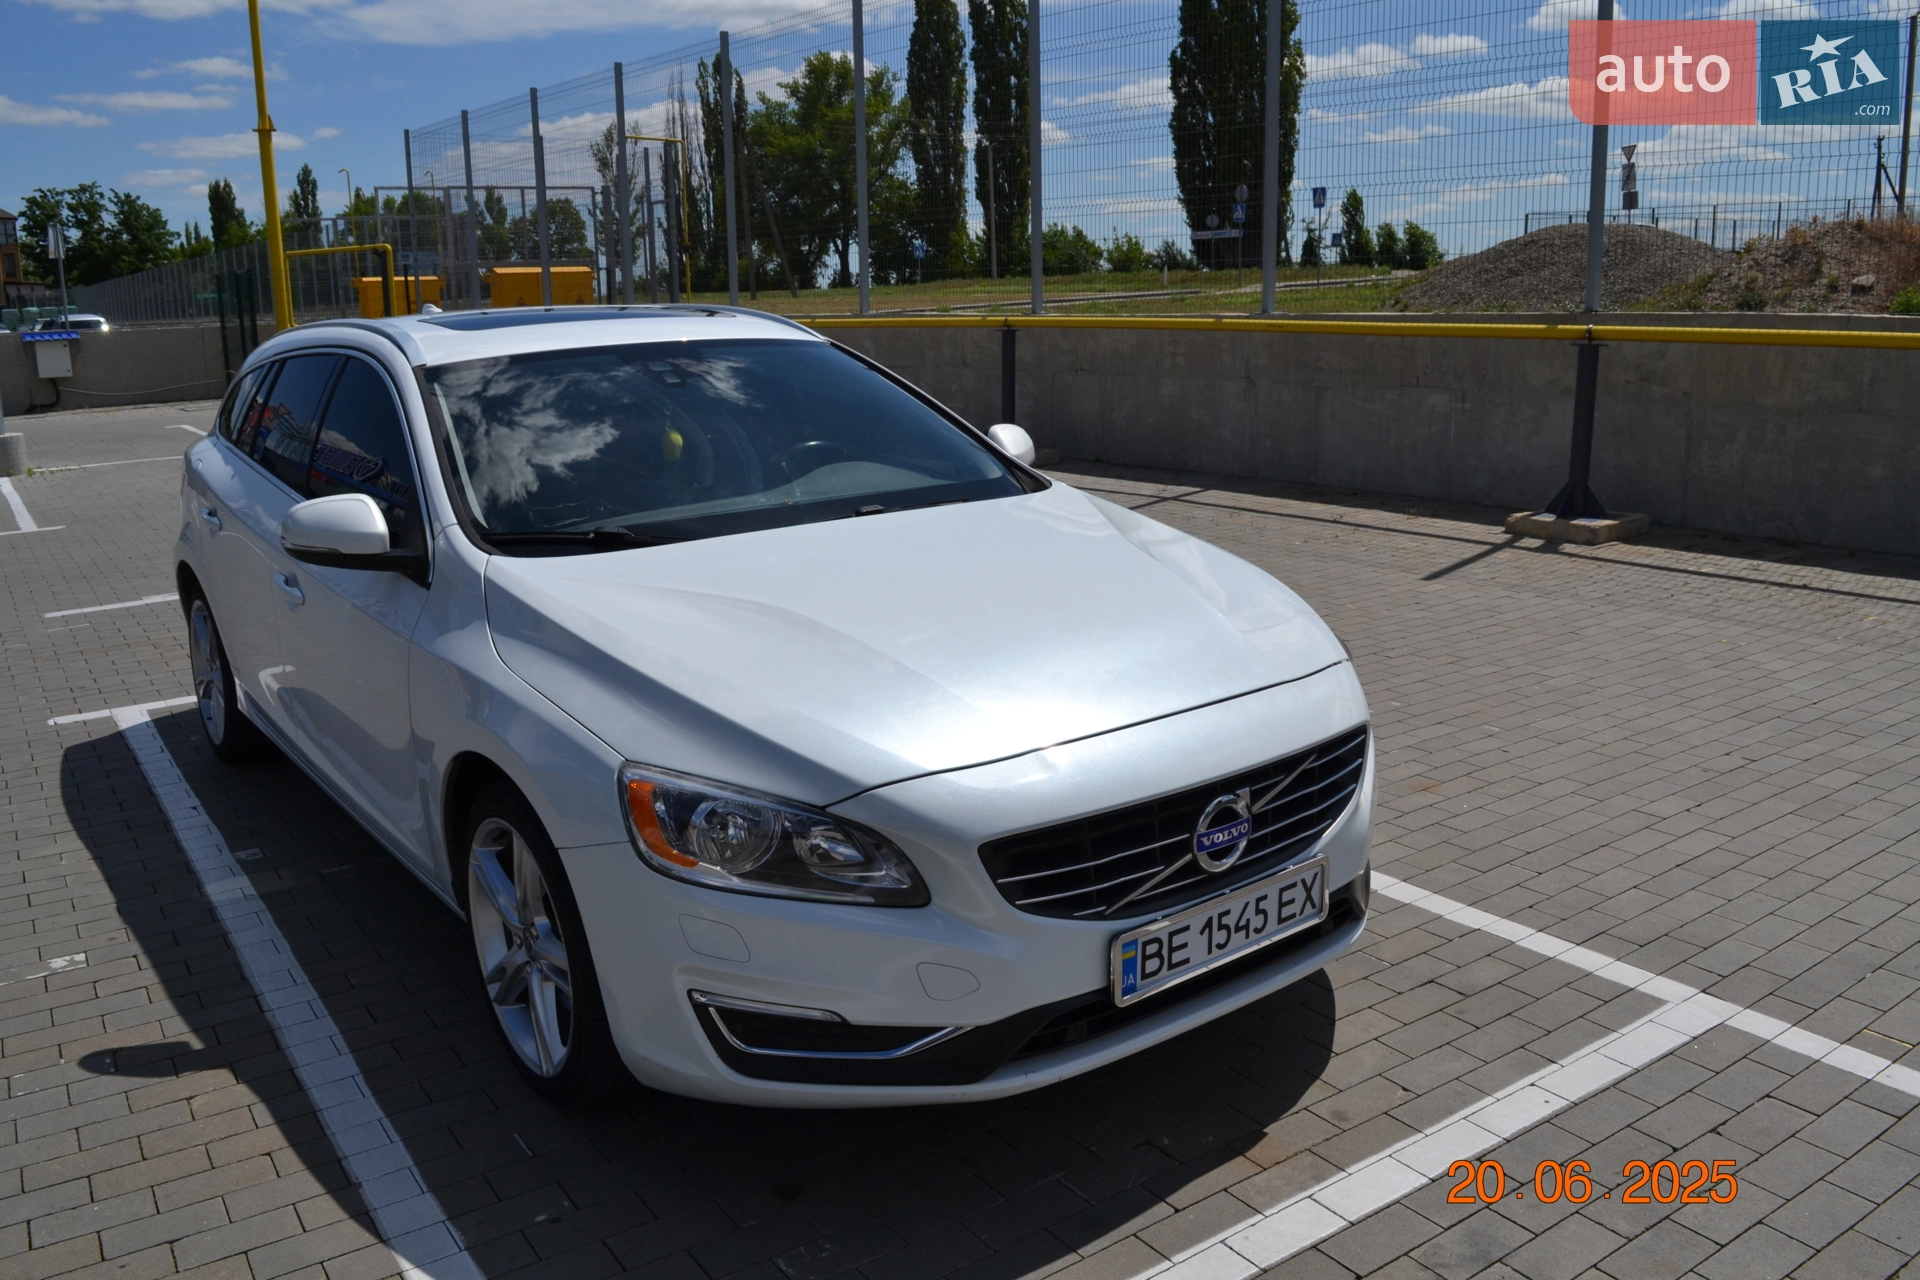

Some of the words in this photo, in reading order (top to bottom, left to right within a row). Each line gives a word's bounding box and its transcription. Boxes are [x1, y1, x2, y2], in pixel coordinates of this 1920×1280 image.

[1201, 822, 1249, 846] VOLVO
[1141, 925, 1190, 981] BE
[1200, 894, 1268, 955] 1545
[1277, 872, 1318, 925] EX
